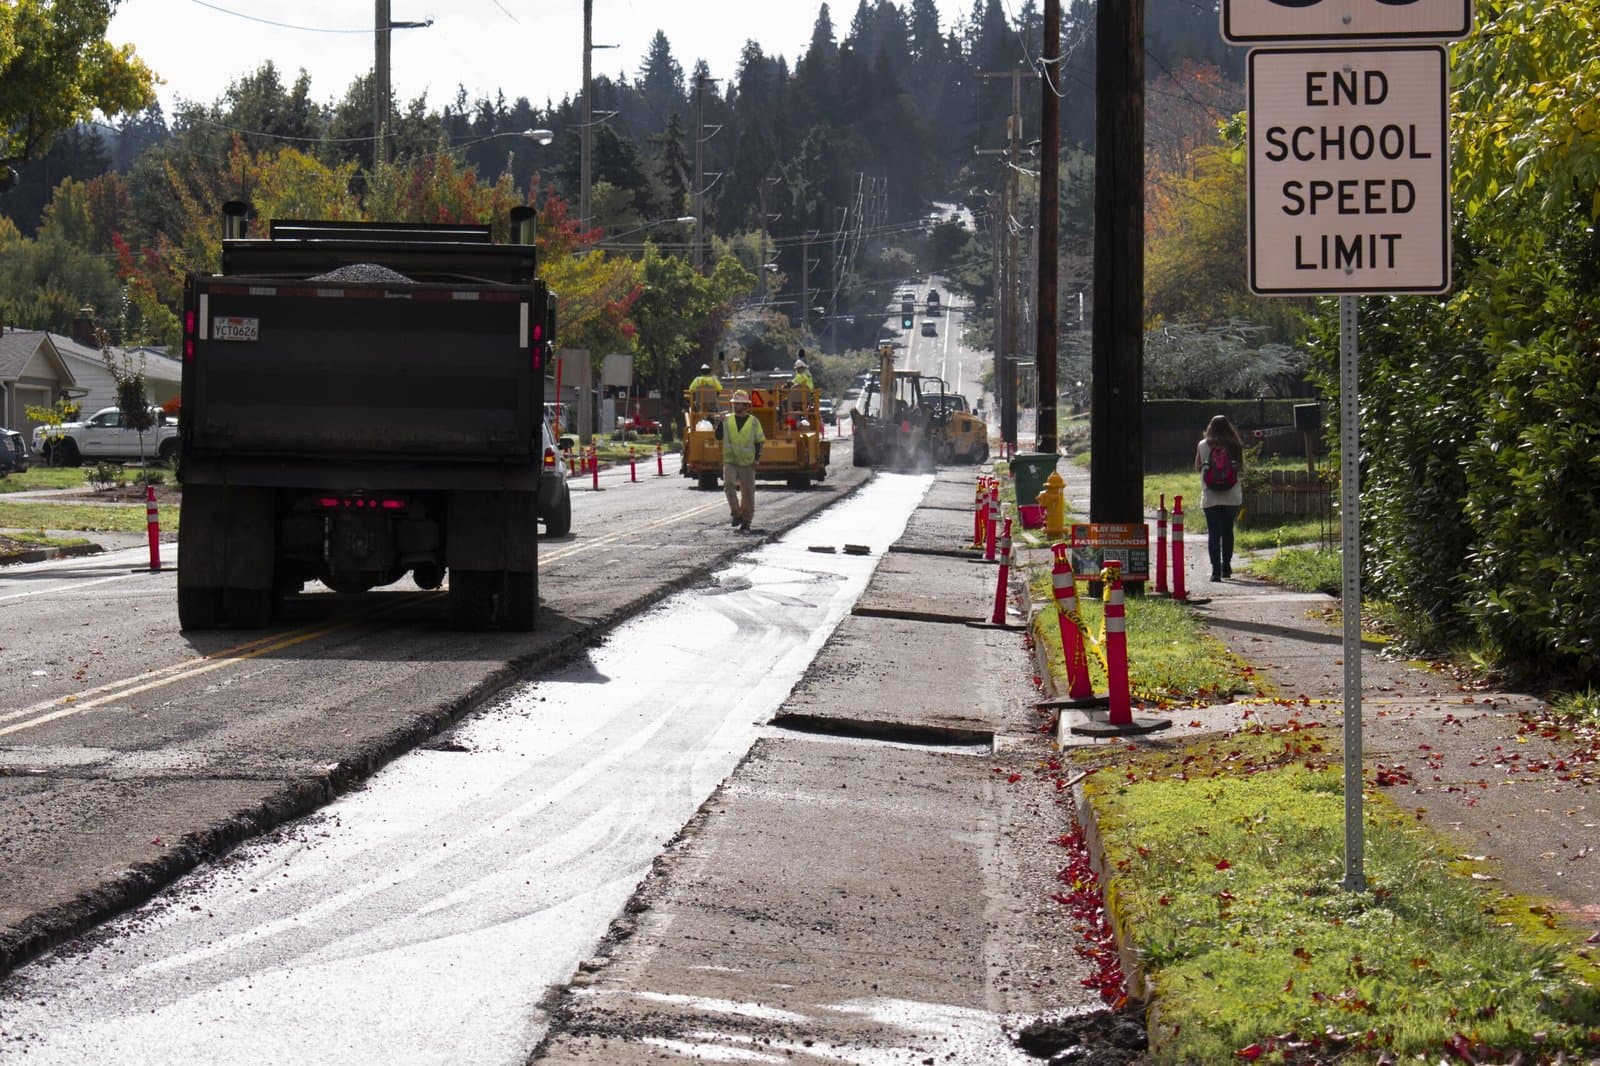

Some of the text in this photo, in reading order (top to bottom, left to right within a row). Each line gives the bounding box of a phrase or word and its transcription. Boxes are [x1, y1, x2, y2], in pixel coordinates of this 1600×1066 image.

[1306, 70, 1389, 106] END
[1265, 124, 1432, 162] SCHOOL
[1281, 179, 1417, 216] SPEED
[1295, 233, 1403, 270] LIMIT
